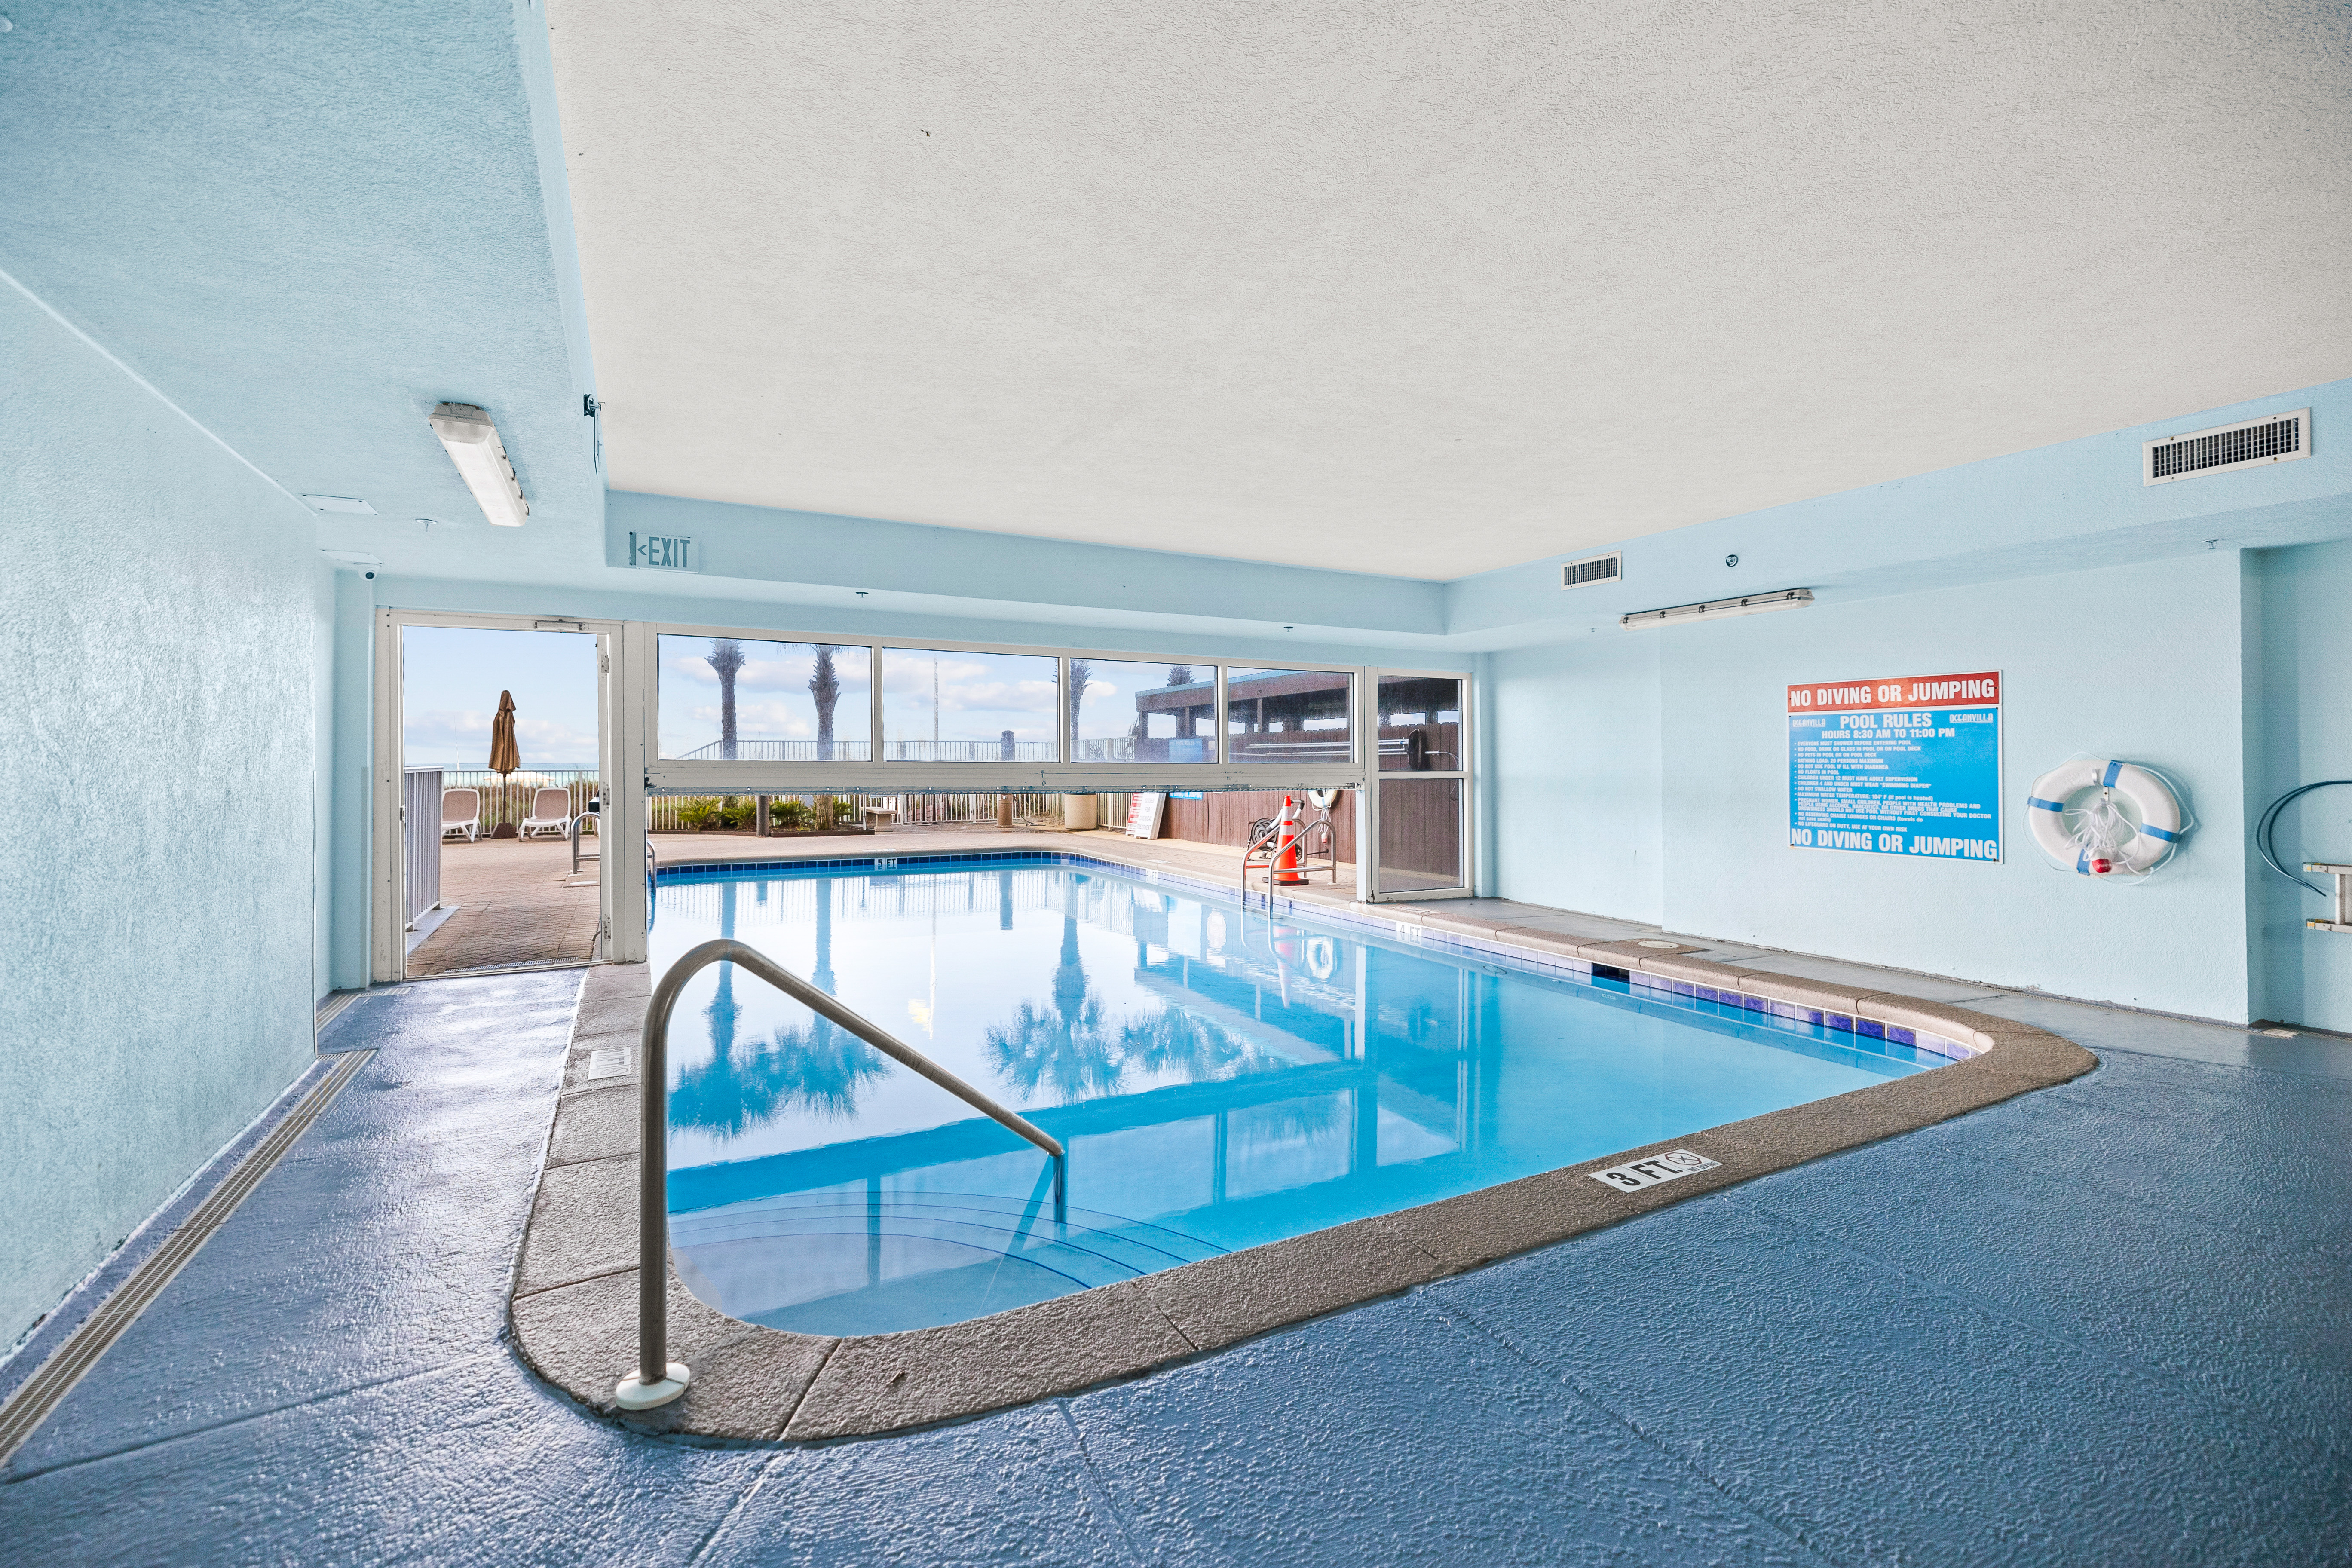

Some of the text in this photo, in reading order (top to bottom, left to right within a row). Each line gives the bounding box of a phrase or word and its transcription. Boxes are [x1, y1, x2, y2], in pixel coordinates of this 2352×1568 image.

[649, 536, 690, 568] EXIT
[1791, 679, 1994, 706] NO DIVING OR JUMPING
[1840, 713, 1932, 729] POOL RULES
[1949, 713, 1993, 723] OCEANVILLA
[1822, 728, 1955, 739] HOURS 8:30 AM TO 11:00 PM
[1791, 828, 1997, 859] NO DIVING OR JUMPING
[1606, 1160, 1684, 1186] 3 FT.
[1700, 1161, 1721, 1171] DIVING
